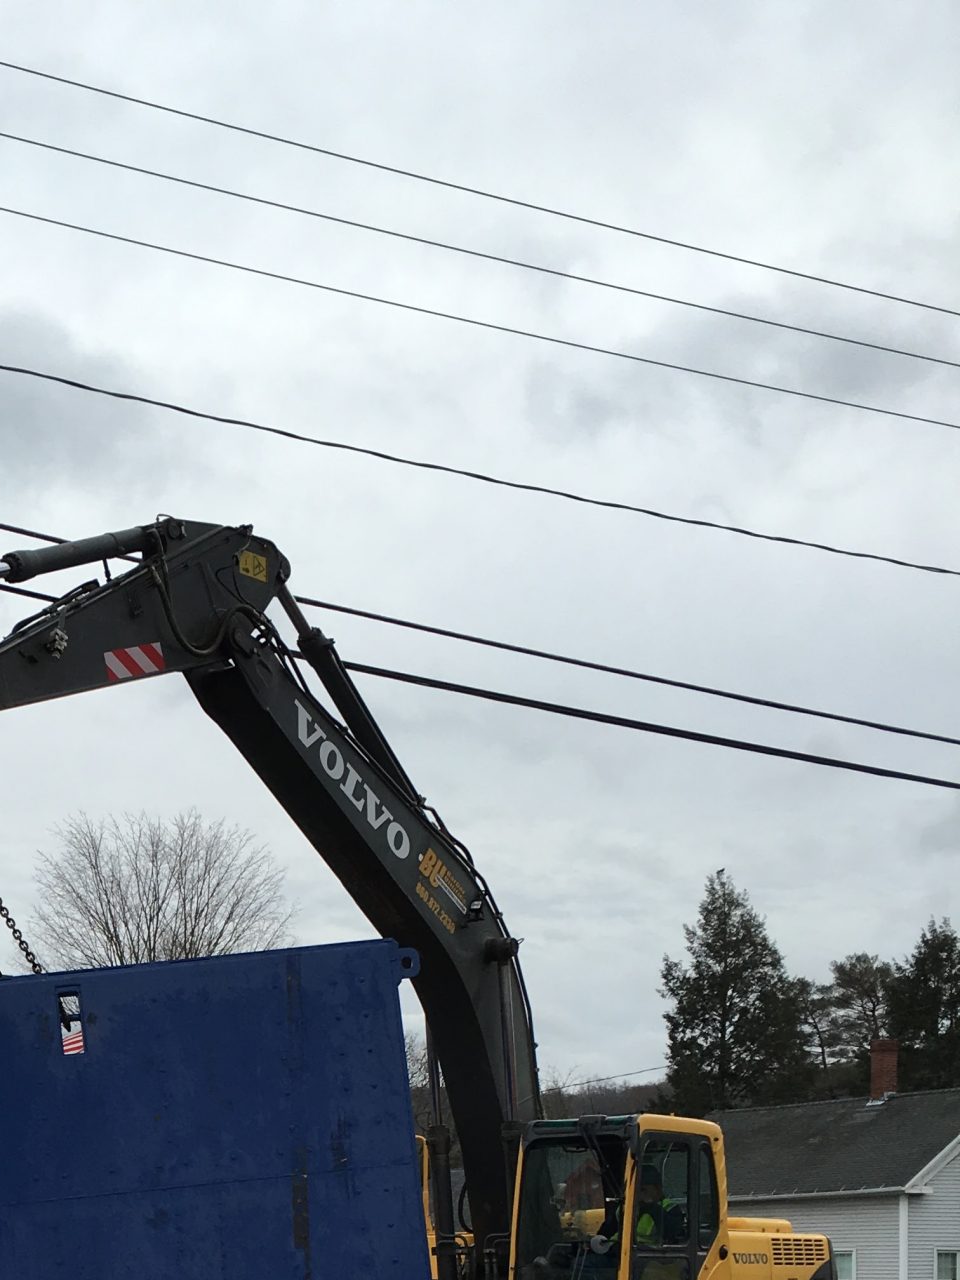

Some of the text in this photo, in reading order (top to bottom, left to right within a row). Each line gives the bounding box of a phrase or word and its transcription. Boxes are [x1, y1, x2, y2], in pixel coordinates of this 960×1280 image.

[294, 698, 411, 860] VOLVO
[418, 847, 448, 889] BU
[732, 1253, 769, 1265] VOLVO
